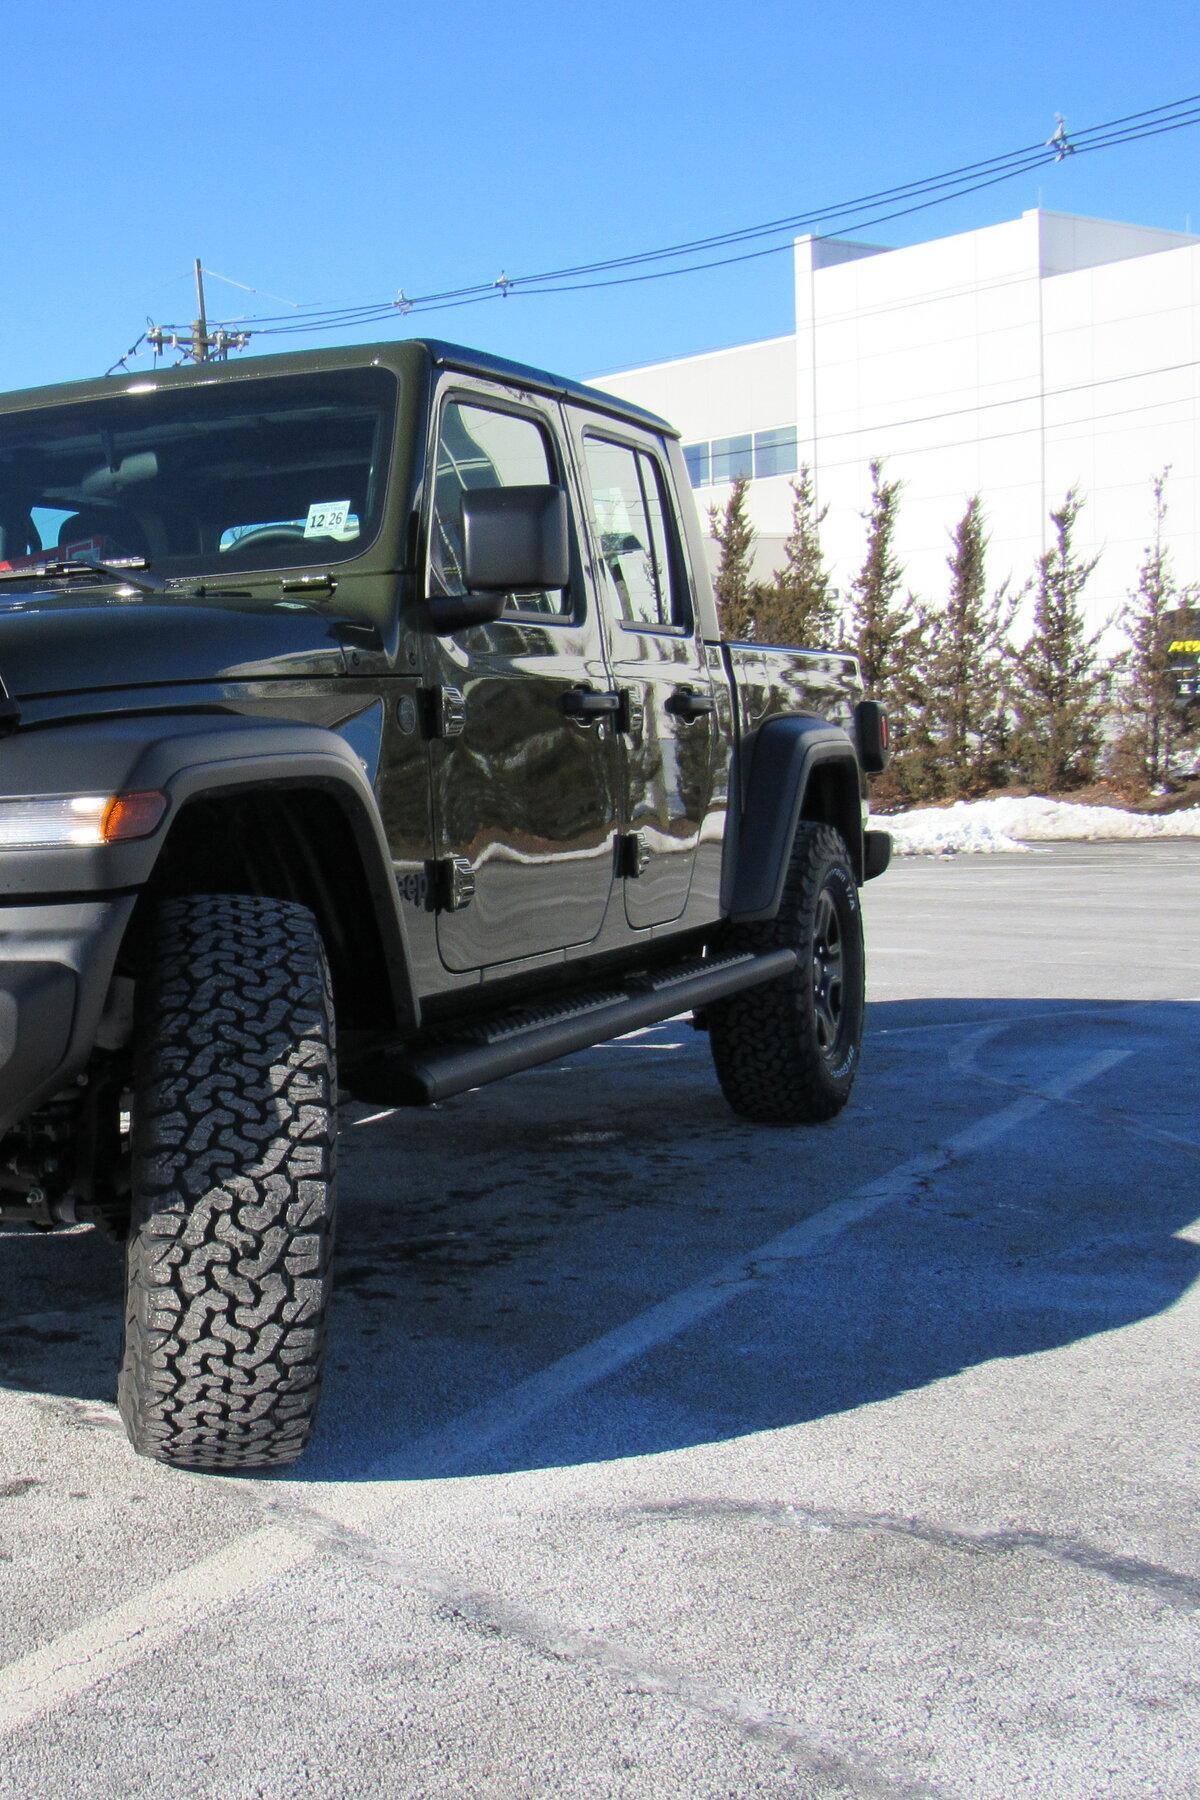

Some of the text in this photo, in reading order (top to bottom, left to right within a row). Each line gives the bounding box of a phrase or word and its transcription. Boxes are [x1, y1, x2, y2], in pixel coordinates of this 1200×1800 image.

[310, 512, 344, 528] 12 26
[396, 873, 428, 907] eep
